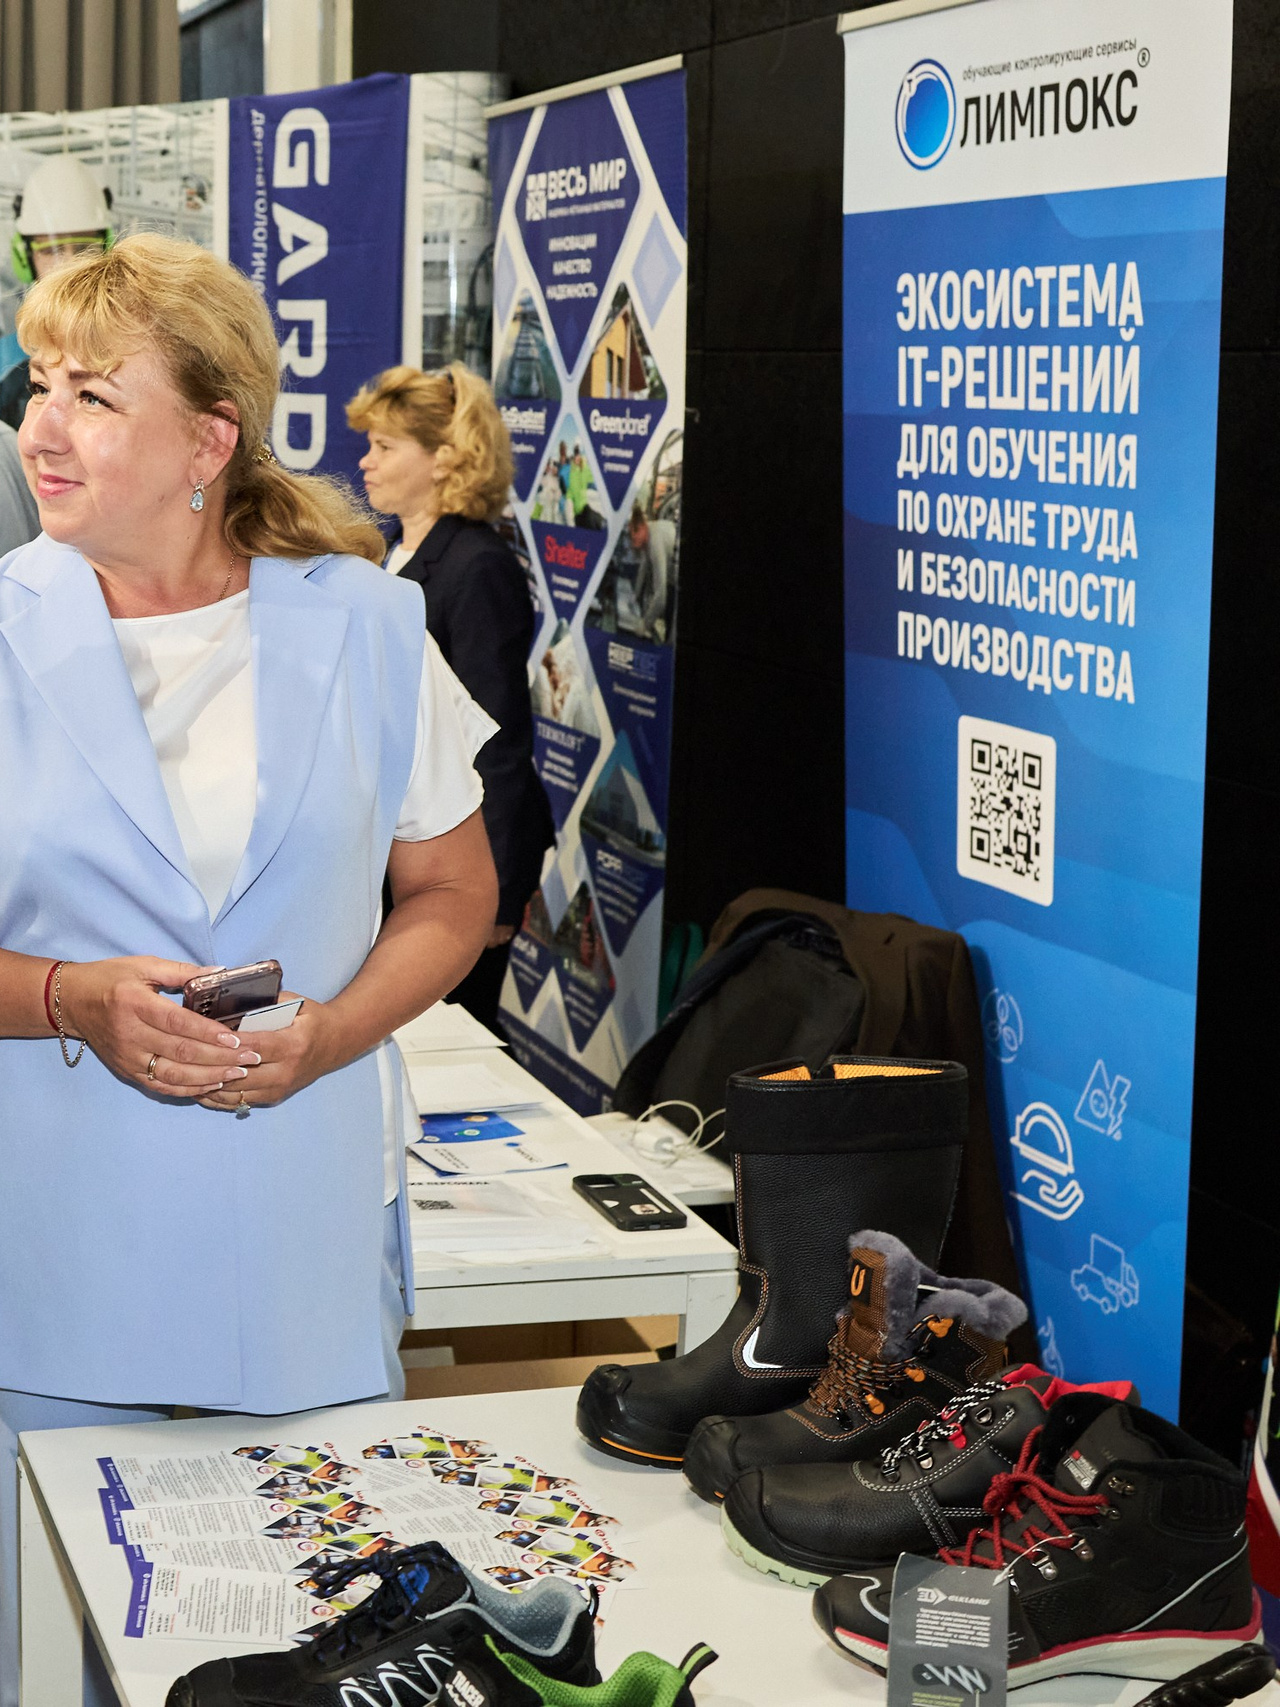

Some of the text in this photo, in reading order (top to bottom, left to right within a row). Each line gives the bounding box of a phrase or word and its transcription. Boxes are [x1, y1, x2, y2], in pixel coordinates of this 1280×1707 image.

[963, 38, 1137, 83] обучающие контролирующие сервисы
[547, 157, 627, 200] ВЕСЬ МИР
[896, 261, 1144, 332] ЭКОСИСТЕМА
[897, 326, 1140, 415] IT-РЕШЕНИЙ
[896, 423, 1138, 490] ДЛЯ ОБУЧЕНИЯ
[897, 489, 1138, 564] ПО ОХРАНЕ ТРУДА
[897, 548, 1136, 628] И БЕЗОПАСНОСТИ
[897, 611, 1136, 704] ПРОИЗВОДСТВА
